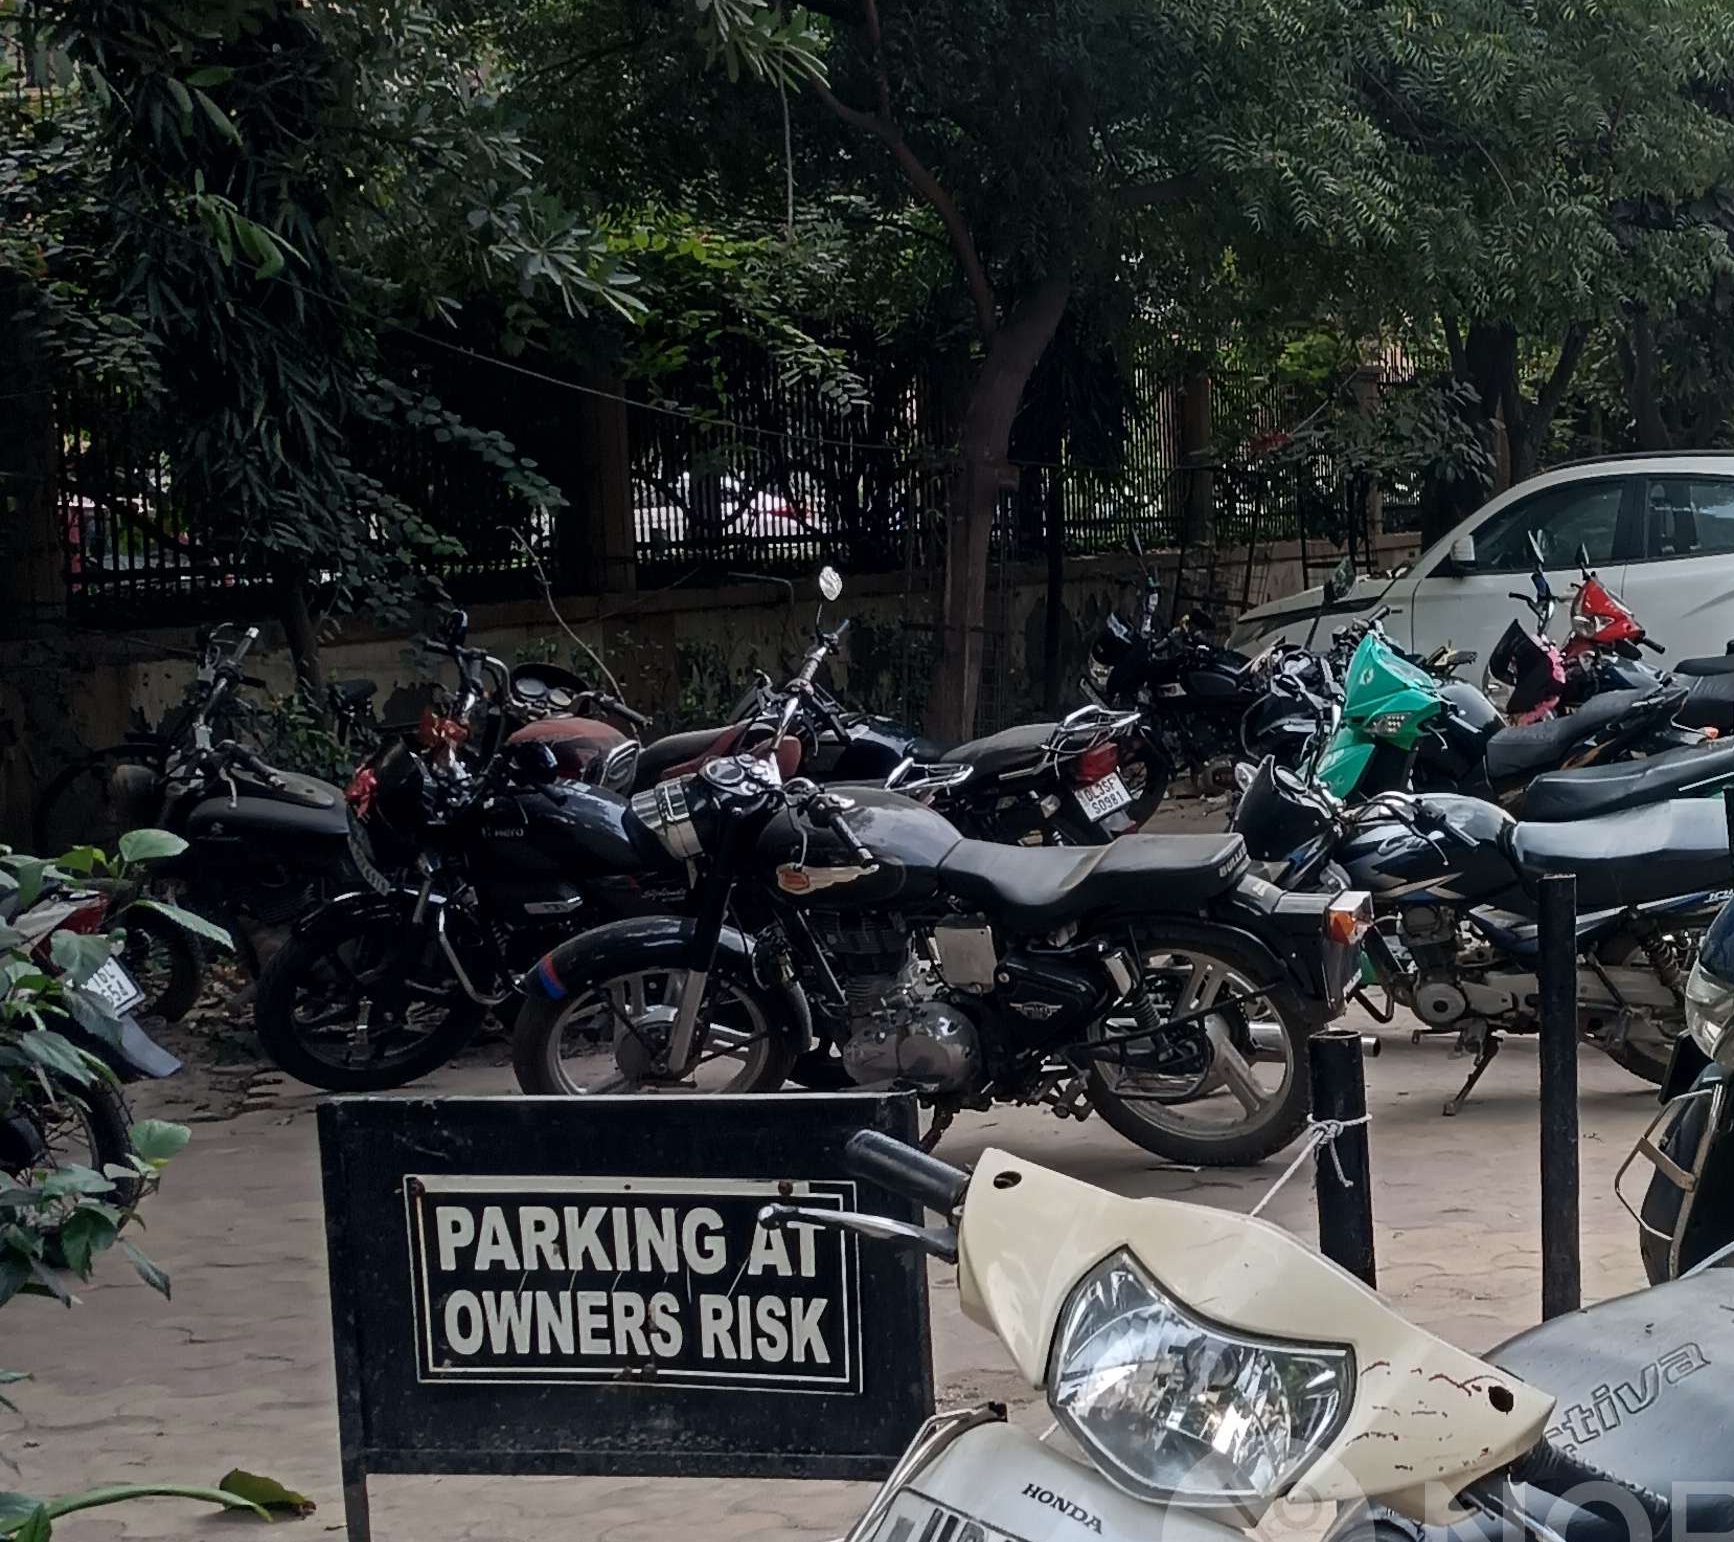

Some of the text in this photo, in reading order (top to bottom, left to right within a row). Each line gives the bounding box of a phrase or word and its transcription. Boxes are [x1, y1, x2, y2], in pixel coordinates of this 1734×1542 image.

[1091, 791, 1125, 815] S0981
[434, 1205, 817, 1278] PARKING AT
[444, 1288, 831, 1364] OWNERS RISK
[1021, 1483, 1104, 1535] HONDA
